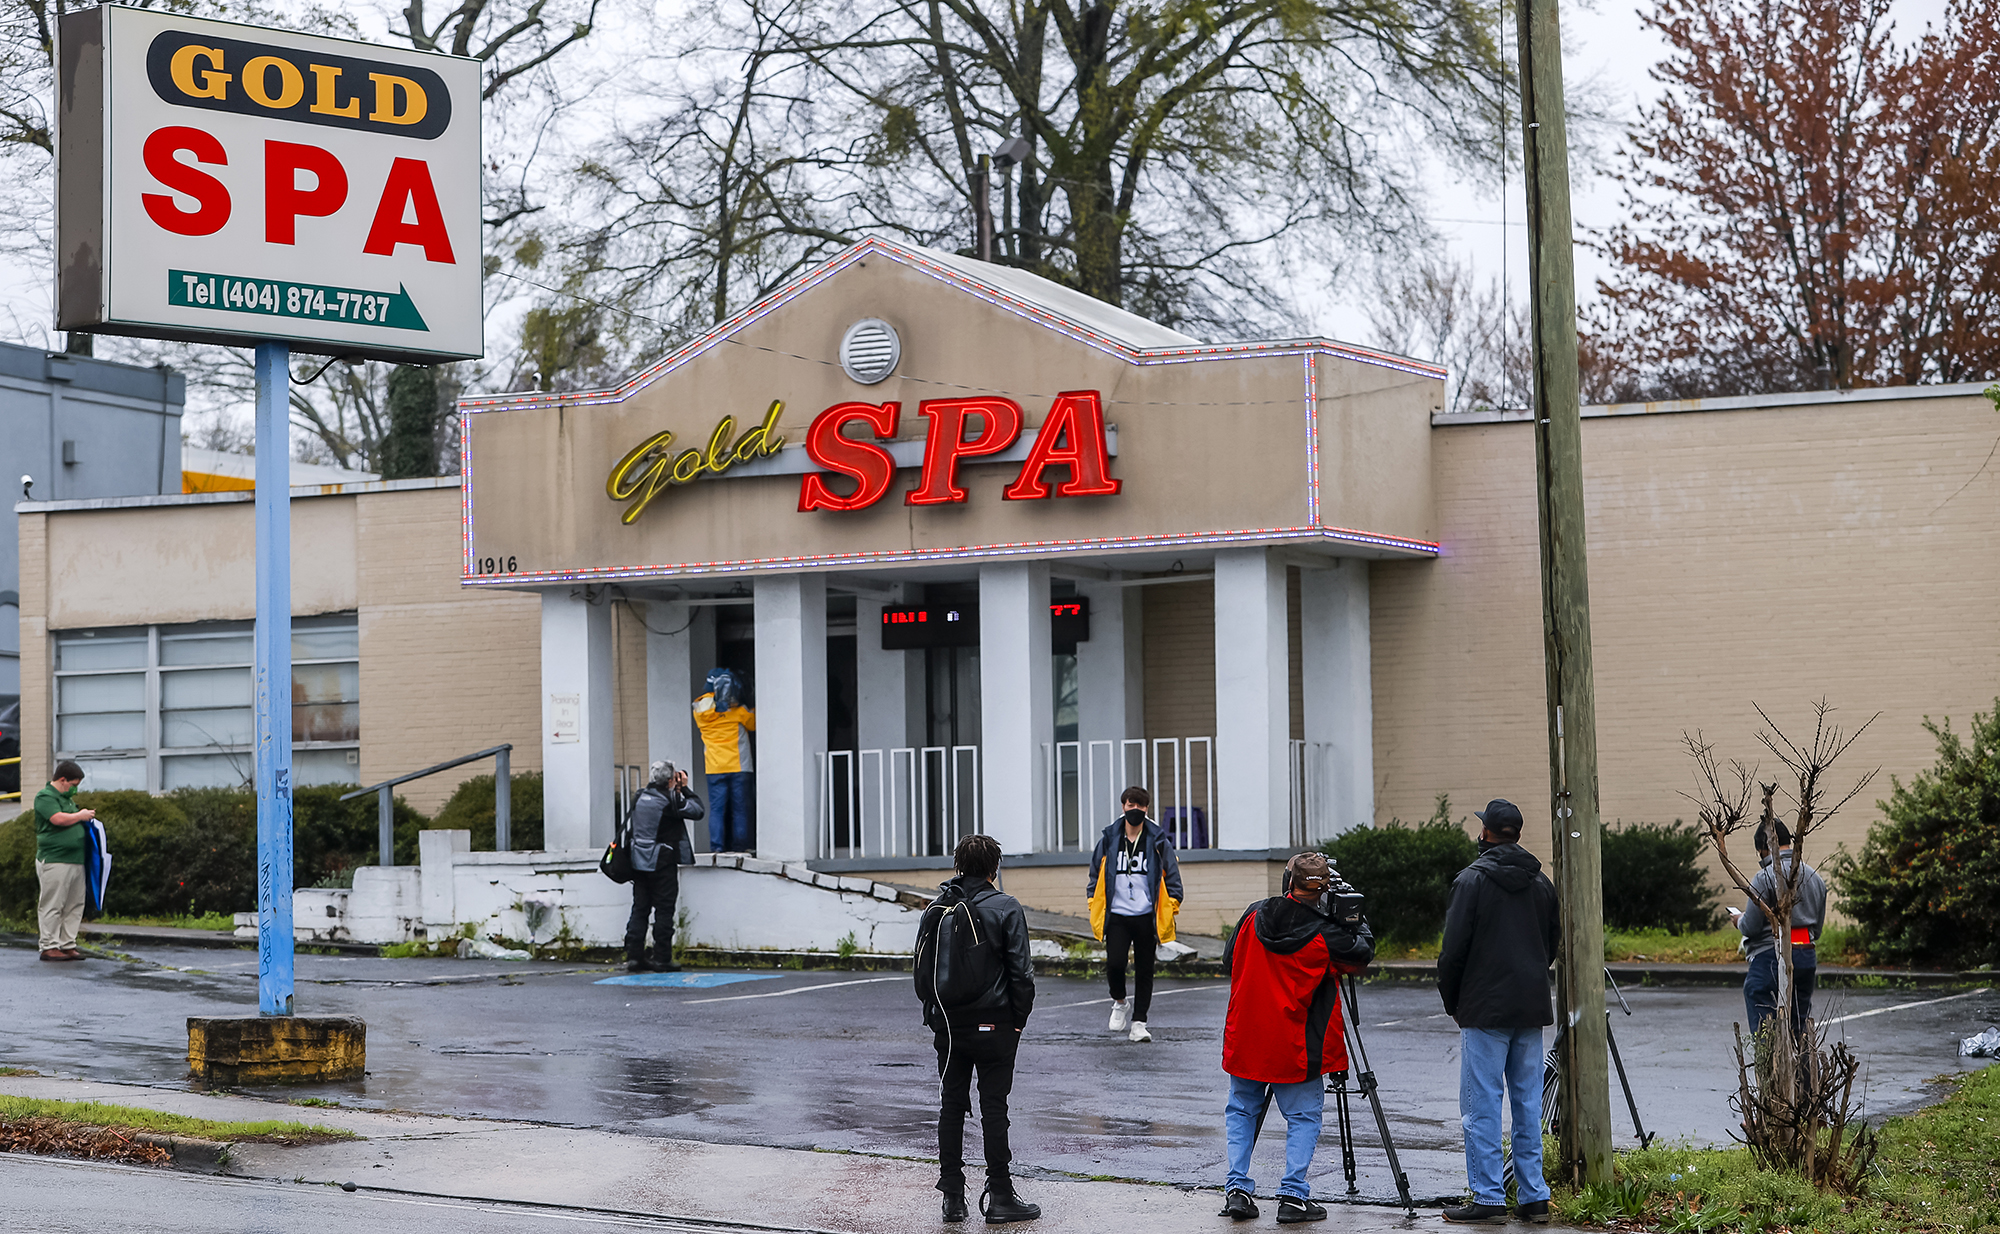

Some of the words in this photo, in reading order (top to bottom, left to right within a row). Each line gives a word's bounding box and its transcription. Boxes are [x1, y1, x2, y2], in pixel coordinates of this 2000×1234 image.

[170, 44, 428, 125] GOLD
[141, 125, 457, 265] SPA
[182, 274, 216, 305] Tel
[222, 279, 280, 314] (404)
[286, 286, 390, 323] 874-7737
[606, 399, 786, 526] Gold
[797, 389, 1123, 513] SPA
[478, 555, 518, 575] 1916
[552, 696, 579, 706] Parking
